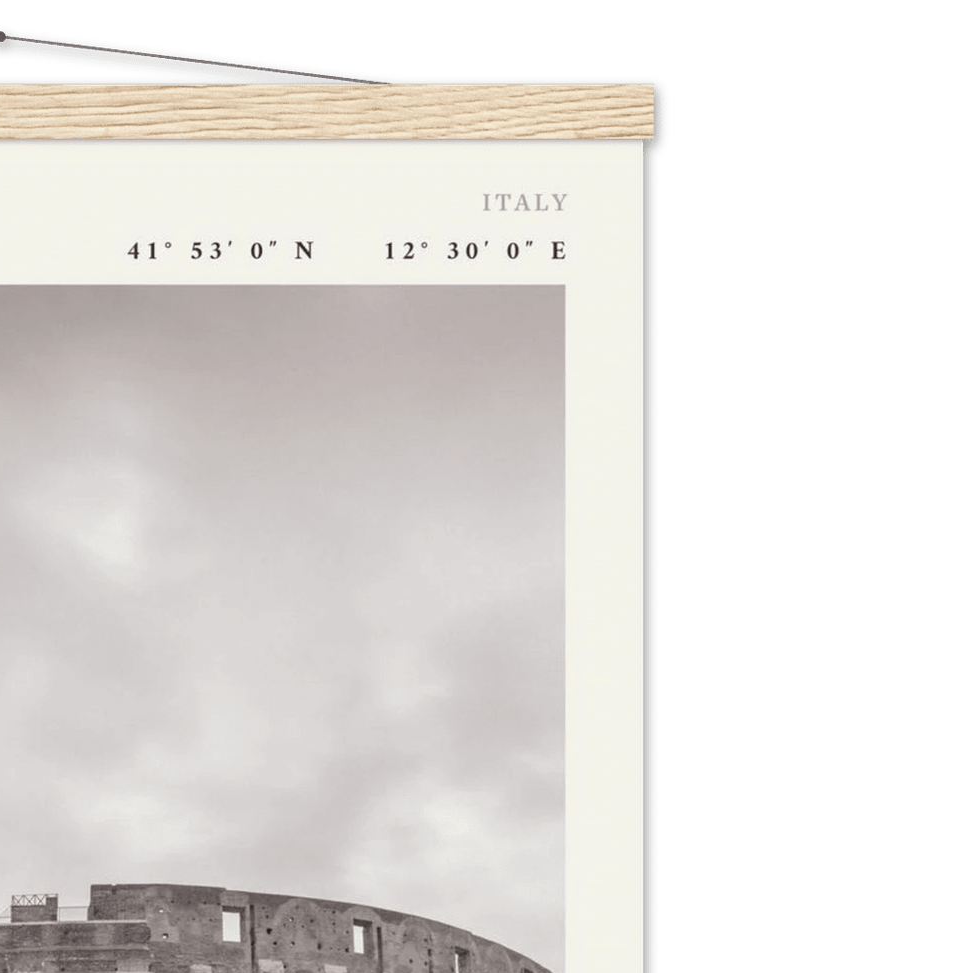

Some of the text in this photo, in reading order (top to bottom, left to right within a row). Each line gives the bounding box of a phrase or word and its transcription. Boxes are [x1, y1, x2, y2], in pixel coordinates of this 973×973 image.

[483, 194, 566, 211] ITALY
[127, 242, 171, 259] 41°
[295, 241, 313, 259] N
[386, 242, 427, 259] 12°
[552, 241, 565, 259] E
